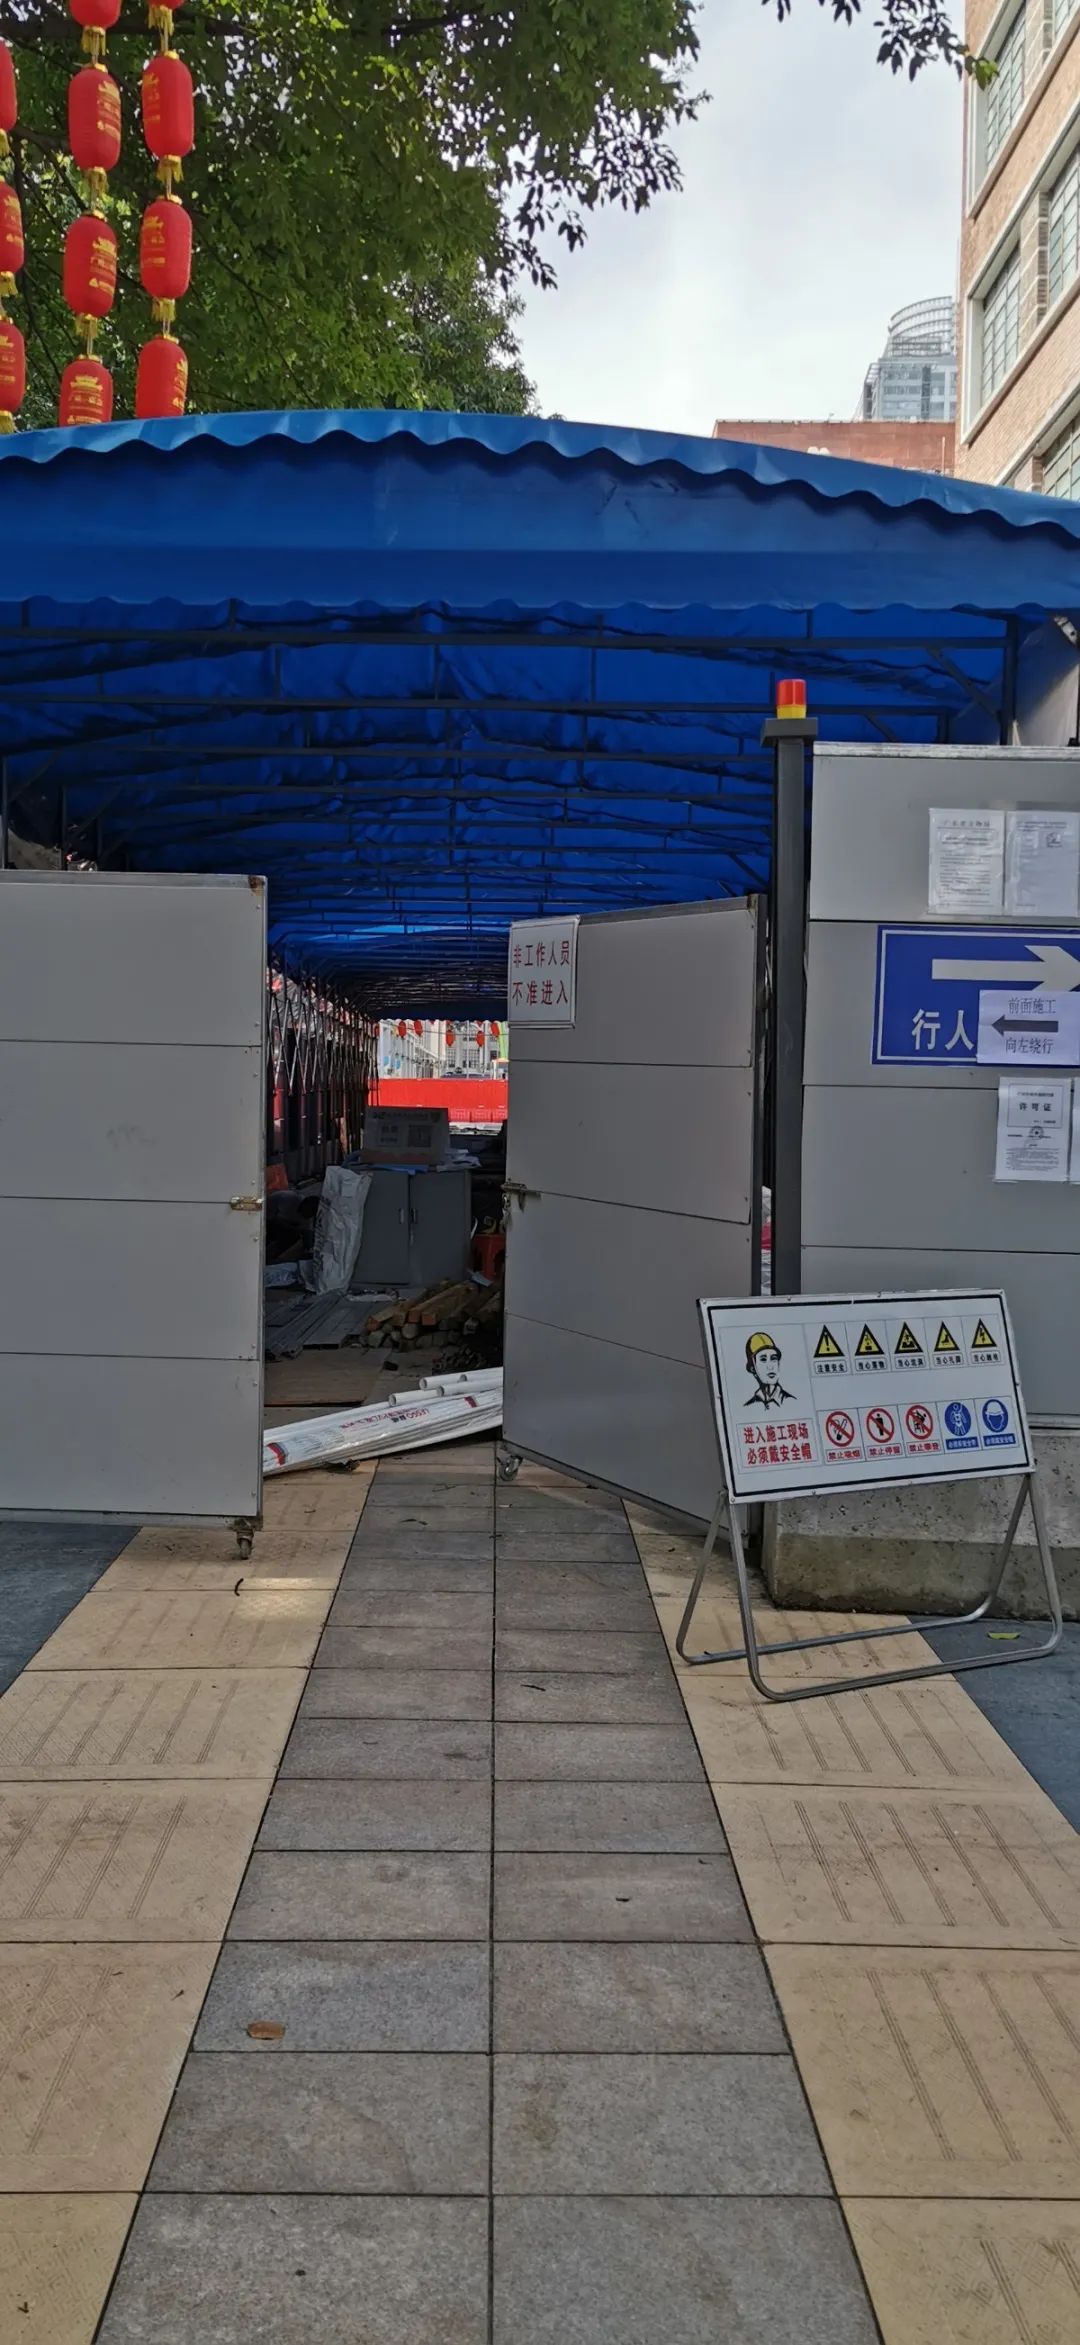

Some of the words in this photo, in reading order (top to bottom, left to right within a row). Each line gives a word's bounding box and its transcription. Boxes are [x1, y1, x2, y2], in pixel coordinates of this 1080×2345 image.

[513, 941, 570, 968] 非工作人员
[512, 979, 568, 1006] 不准进入
[1008, 998, 1056, 1014] 前面施工
[912, 1009, 975, 1050] 行人
[1006, 1037, 1054, 1054] 向左绕行
[1019, 1102, 1052, 1112] 许可证
[744, 1422, 809, 1443] 进入施工现场
[747, 1443, 812, 1464] 必须戴安全帽
[828, 1449, 860, 1460] 禁止吸烟
[869, 1446, 901, 1456] 禁止停留
